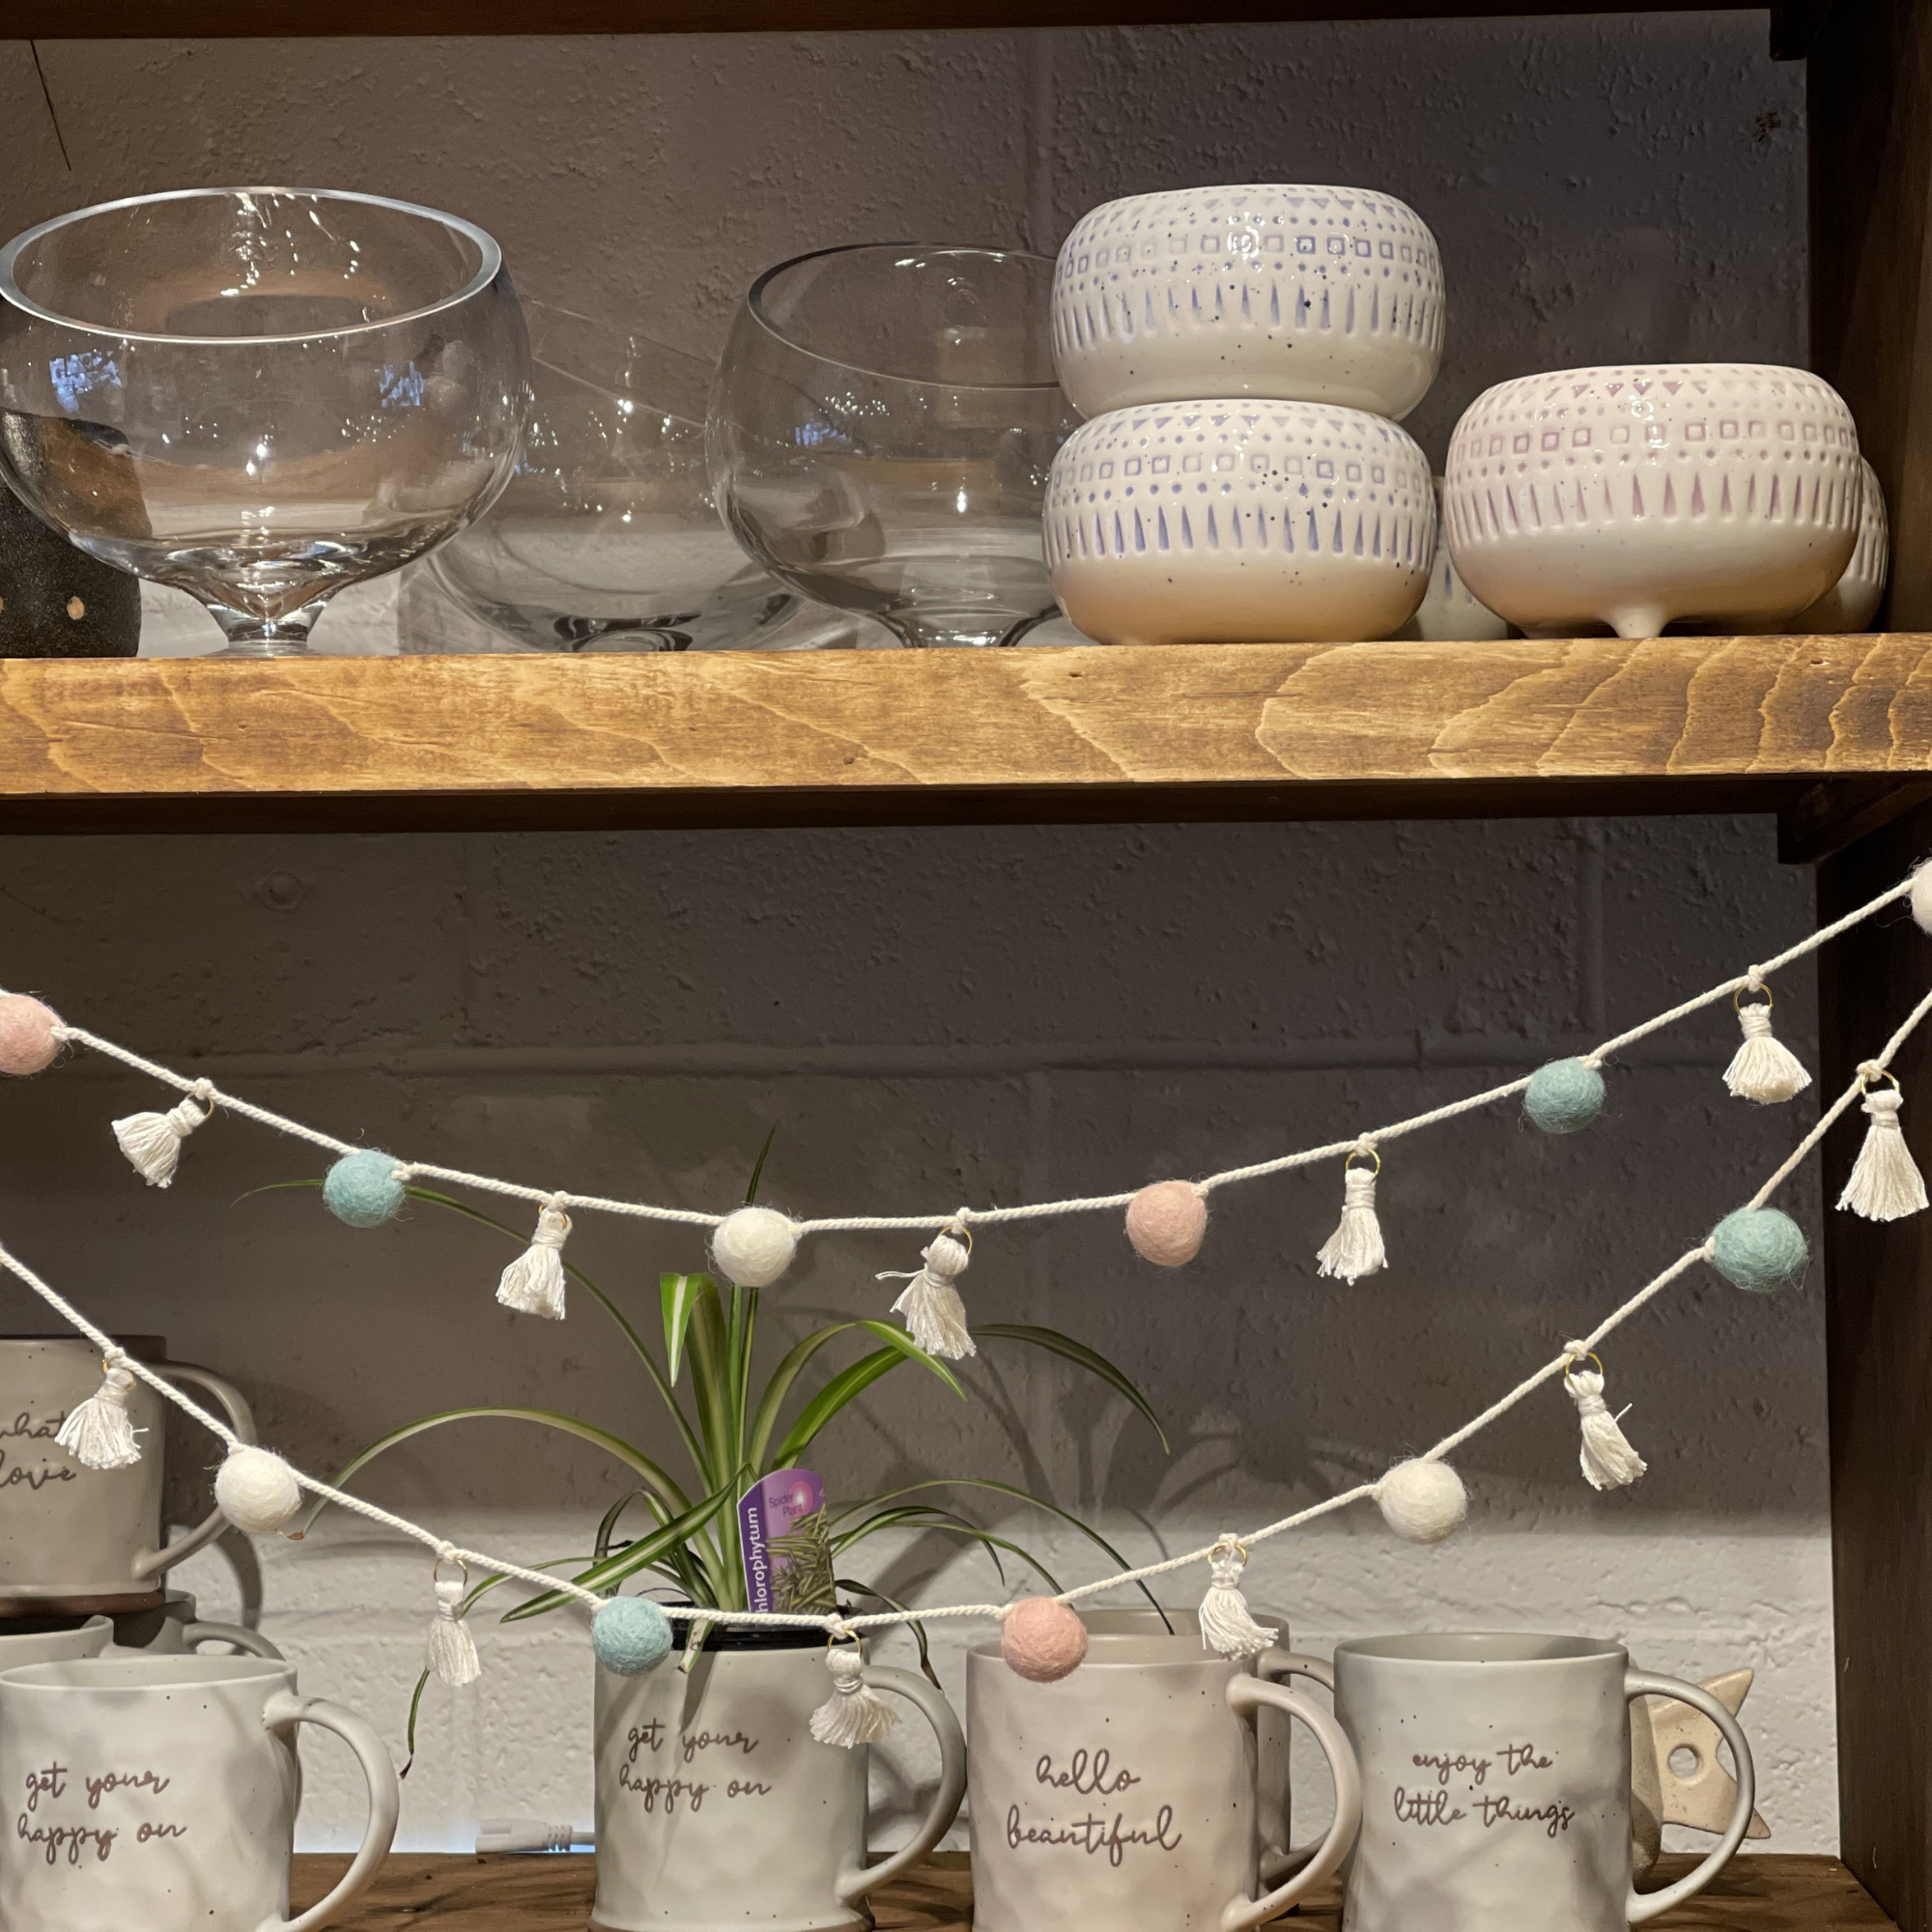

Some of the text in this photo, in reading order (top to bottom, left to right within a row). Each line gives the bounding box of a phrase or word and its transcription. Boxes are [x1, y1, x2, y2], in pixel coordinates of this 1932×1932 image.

[0, 1410, 68, 1439] hat
[768, 1493, 794, 1510] Spider
[782, 1502, 803, 1518] Plant
[747, 1507, 769, 1613] hlorophytum
[628, 1718, 759, 1763] get your
[1412, 1744, 1553, 1785] enjoy the
[26, 1761, 171, 1812] get your
[619, 1763, 772, 1814] happy on
[1036, 1748, 1142, 1795] hello
[1007, 1804, 1182, 1867] beautiful
[1394, 1786, 1576, 1838] little things
[17, 1812, 187, 1865] happy on
